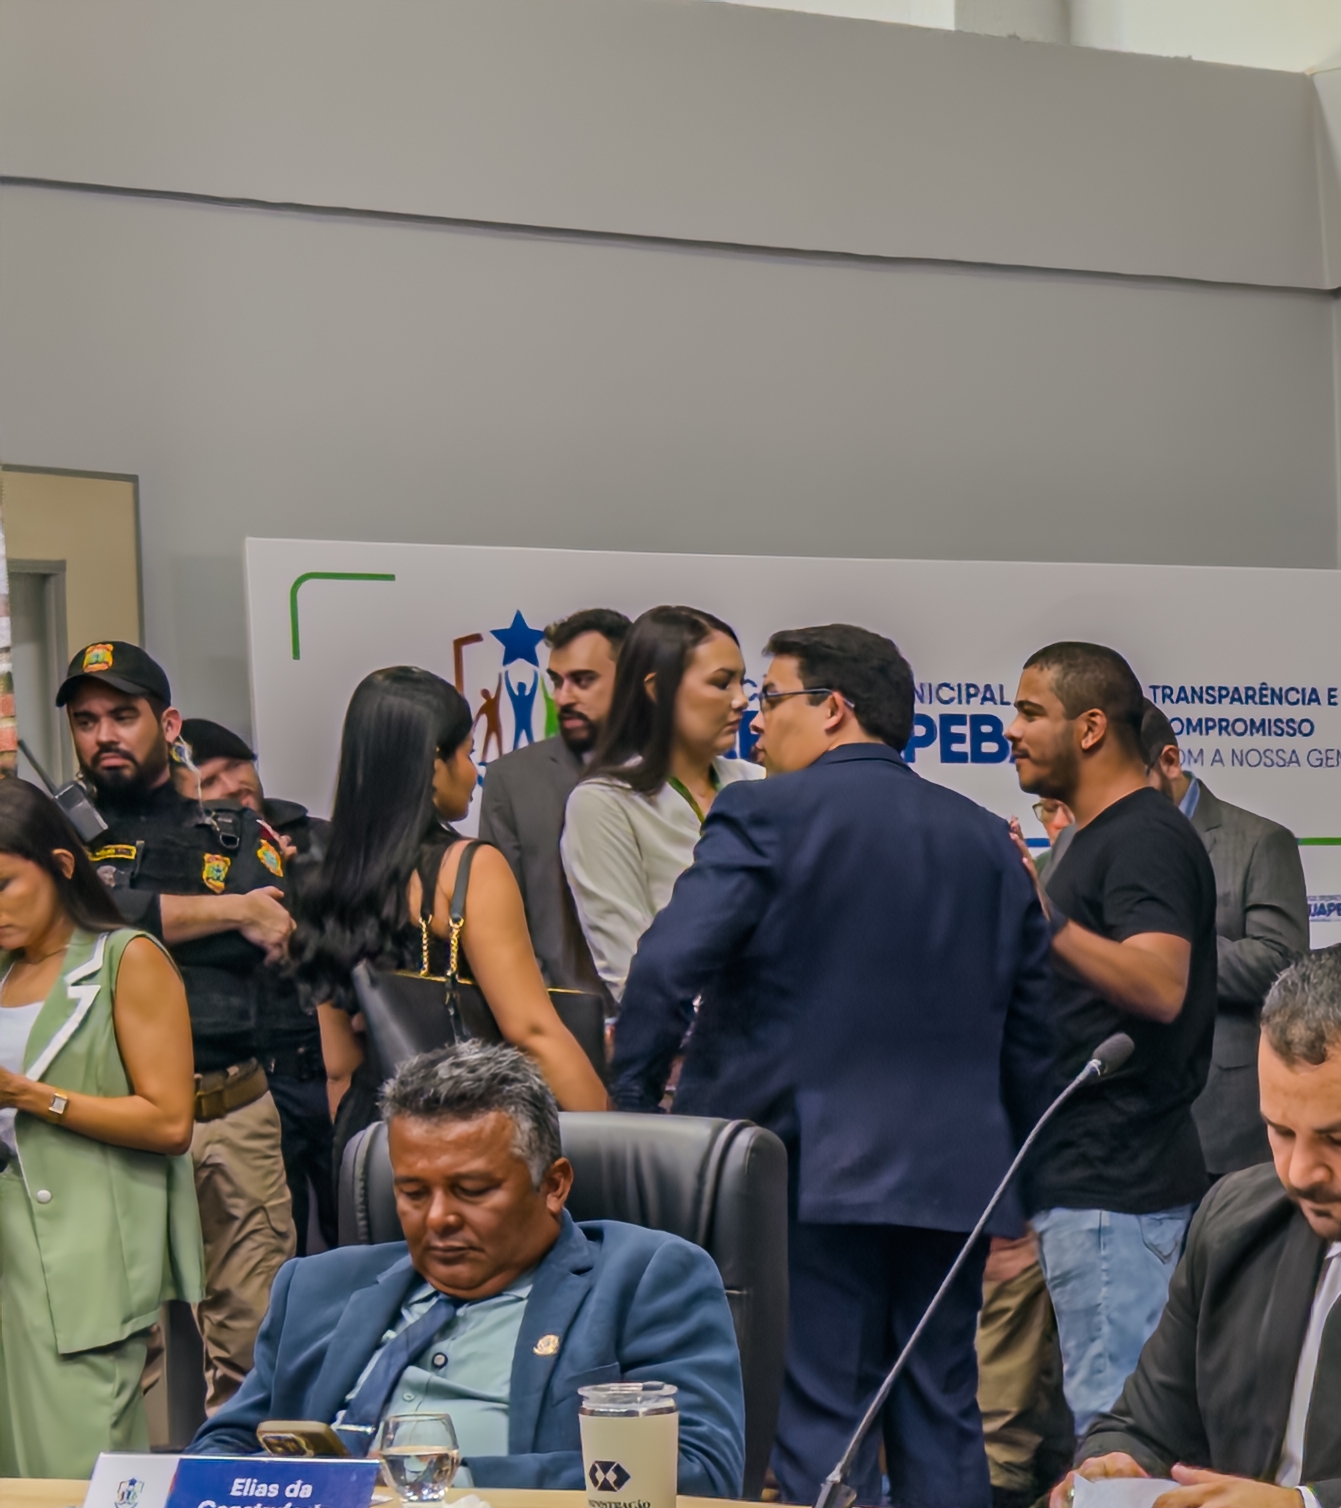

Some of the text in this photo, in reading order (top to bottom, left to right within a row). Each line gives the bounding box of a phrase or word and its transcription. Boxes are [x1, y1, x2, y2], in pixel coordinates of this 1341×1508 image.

[915, 682, 1012, 706] NICIPAL
[1149, 681, 1339, 706] TRANSPARÊNCIA E
[1169, 717, 1315, 737] OMPROMISSO
[1210, 749, 1225, 767] A
[1231, 748, 1301, 768] NOSSA
[230, 1478, 313, 1499] Elias da
